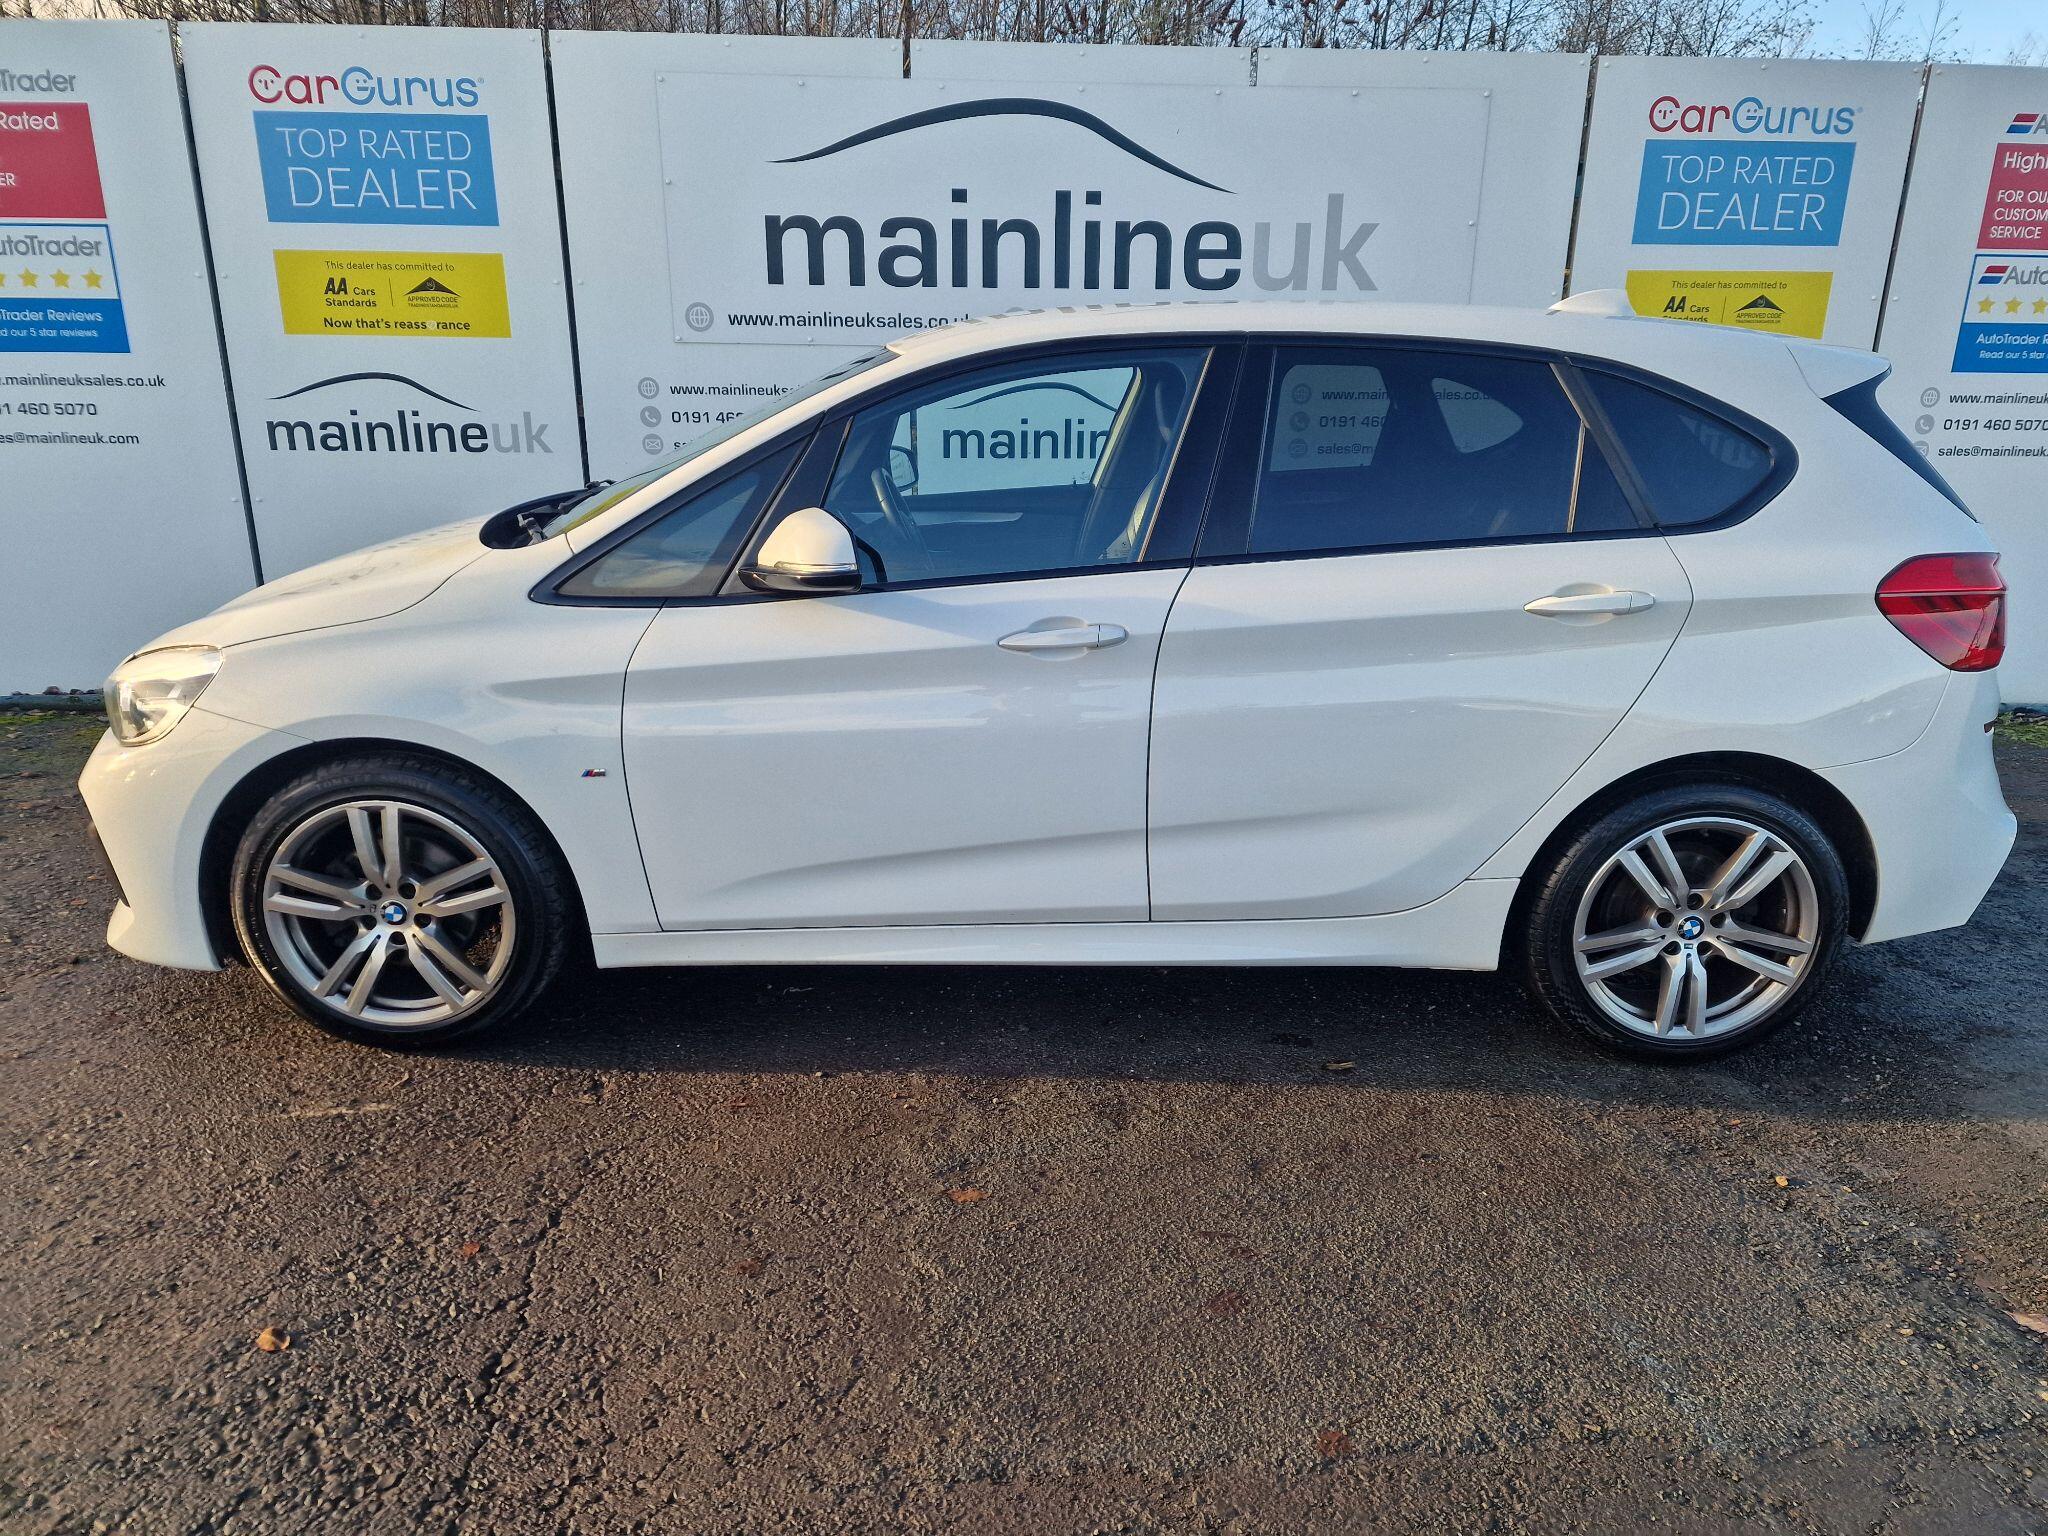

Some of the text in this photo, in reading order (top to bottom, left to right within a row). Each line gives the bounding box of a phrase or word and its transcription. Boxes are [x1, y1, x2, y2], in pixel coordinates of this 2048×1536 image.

[248, 64, 480, 107] CarGurus
[0, 112, 59, 130] Rated
[1649, 95, 1856, 135] CarGurus
[275, 127, 472, 160] TOP RATED
[1661, 155, 1835, 185] TOP RATED
[288, 166, 478, 209] DEALER
[1997, 189, 2048, 204] FOR OU
[1657, 192, 1826, 231] DEALER
[1994, 207, 2048, 221] CUSTOM
[1989, 225, 2043, 239] SERVICE
[765, 188, 1381, 292] mainlineuk
[325, 260, 455, 271] This dealer has committed to
[324, 277, 376, 296] AA Cars
[1671, 280, 1788, 290] This dealer has committed to
[326, 298, 377, 307] Standards
[407, 295, 440, 303] APPROVED
[1663, 296, 1710, 313] AA Cars
[48, 309, 104, 322] Reviews
[324, 317, 471, 330] Now that's reassrance
[10, 328, 28, 337] our
[29, 327, 37, 337] 5
[38, 328, 58, 337] star
[60, 328, 99, 337] reviews
[1976, 333, 2040, 345] AutoTrader
[1979, 351, 2004, 359] Read
[2029, 350, 2046, 359] star
[17, 402, 49, 415] 460
[54, 402, 98, 415] 5070
[671, 411, 710, 423] 0191
[1319, 415, 1356, 428] 0191
[266, 409, 554, 453] mainlineuk
[1943, 418, 1979, 431] 0191
[1983, 418, 2011, 431] 460
